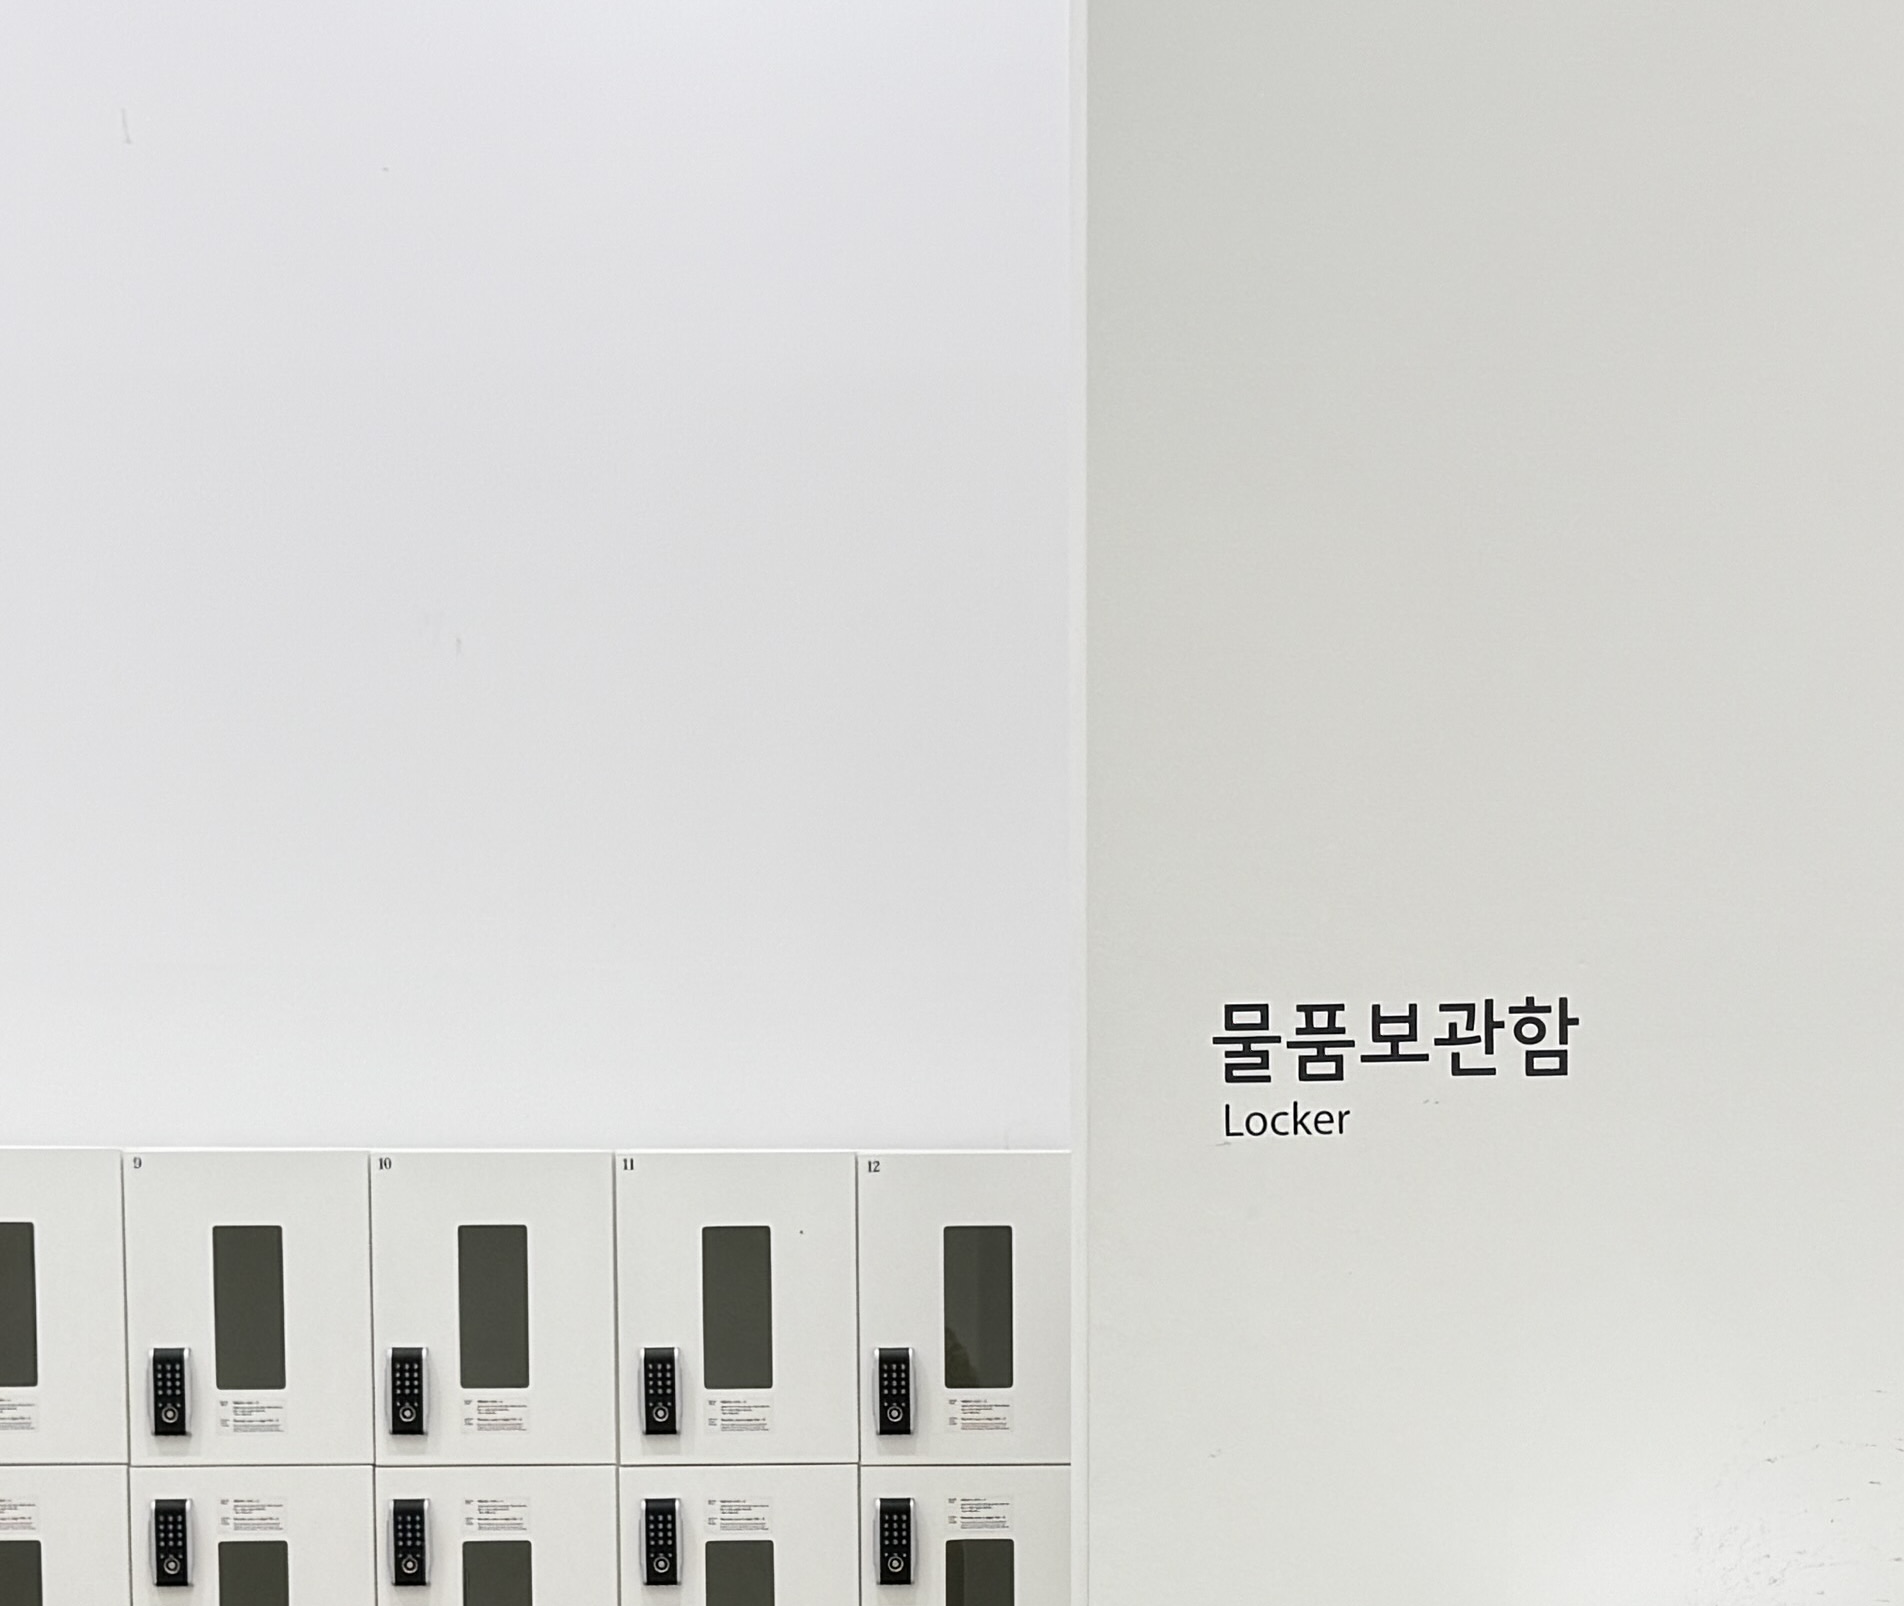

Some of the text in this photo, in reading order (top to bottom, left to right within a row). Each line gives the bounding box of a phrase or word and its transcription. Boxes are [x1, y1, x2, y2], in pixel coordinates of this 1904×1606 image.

[1212, 996, 1580, 1084] 물품보관함
[1224, 1100, 1351, 1137] Locker
[379, 1157, 392, 1170] 10
[623, 1158, 634, 1171] 11
[867, 1160, 881, 1173] 12
